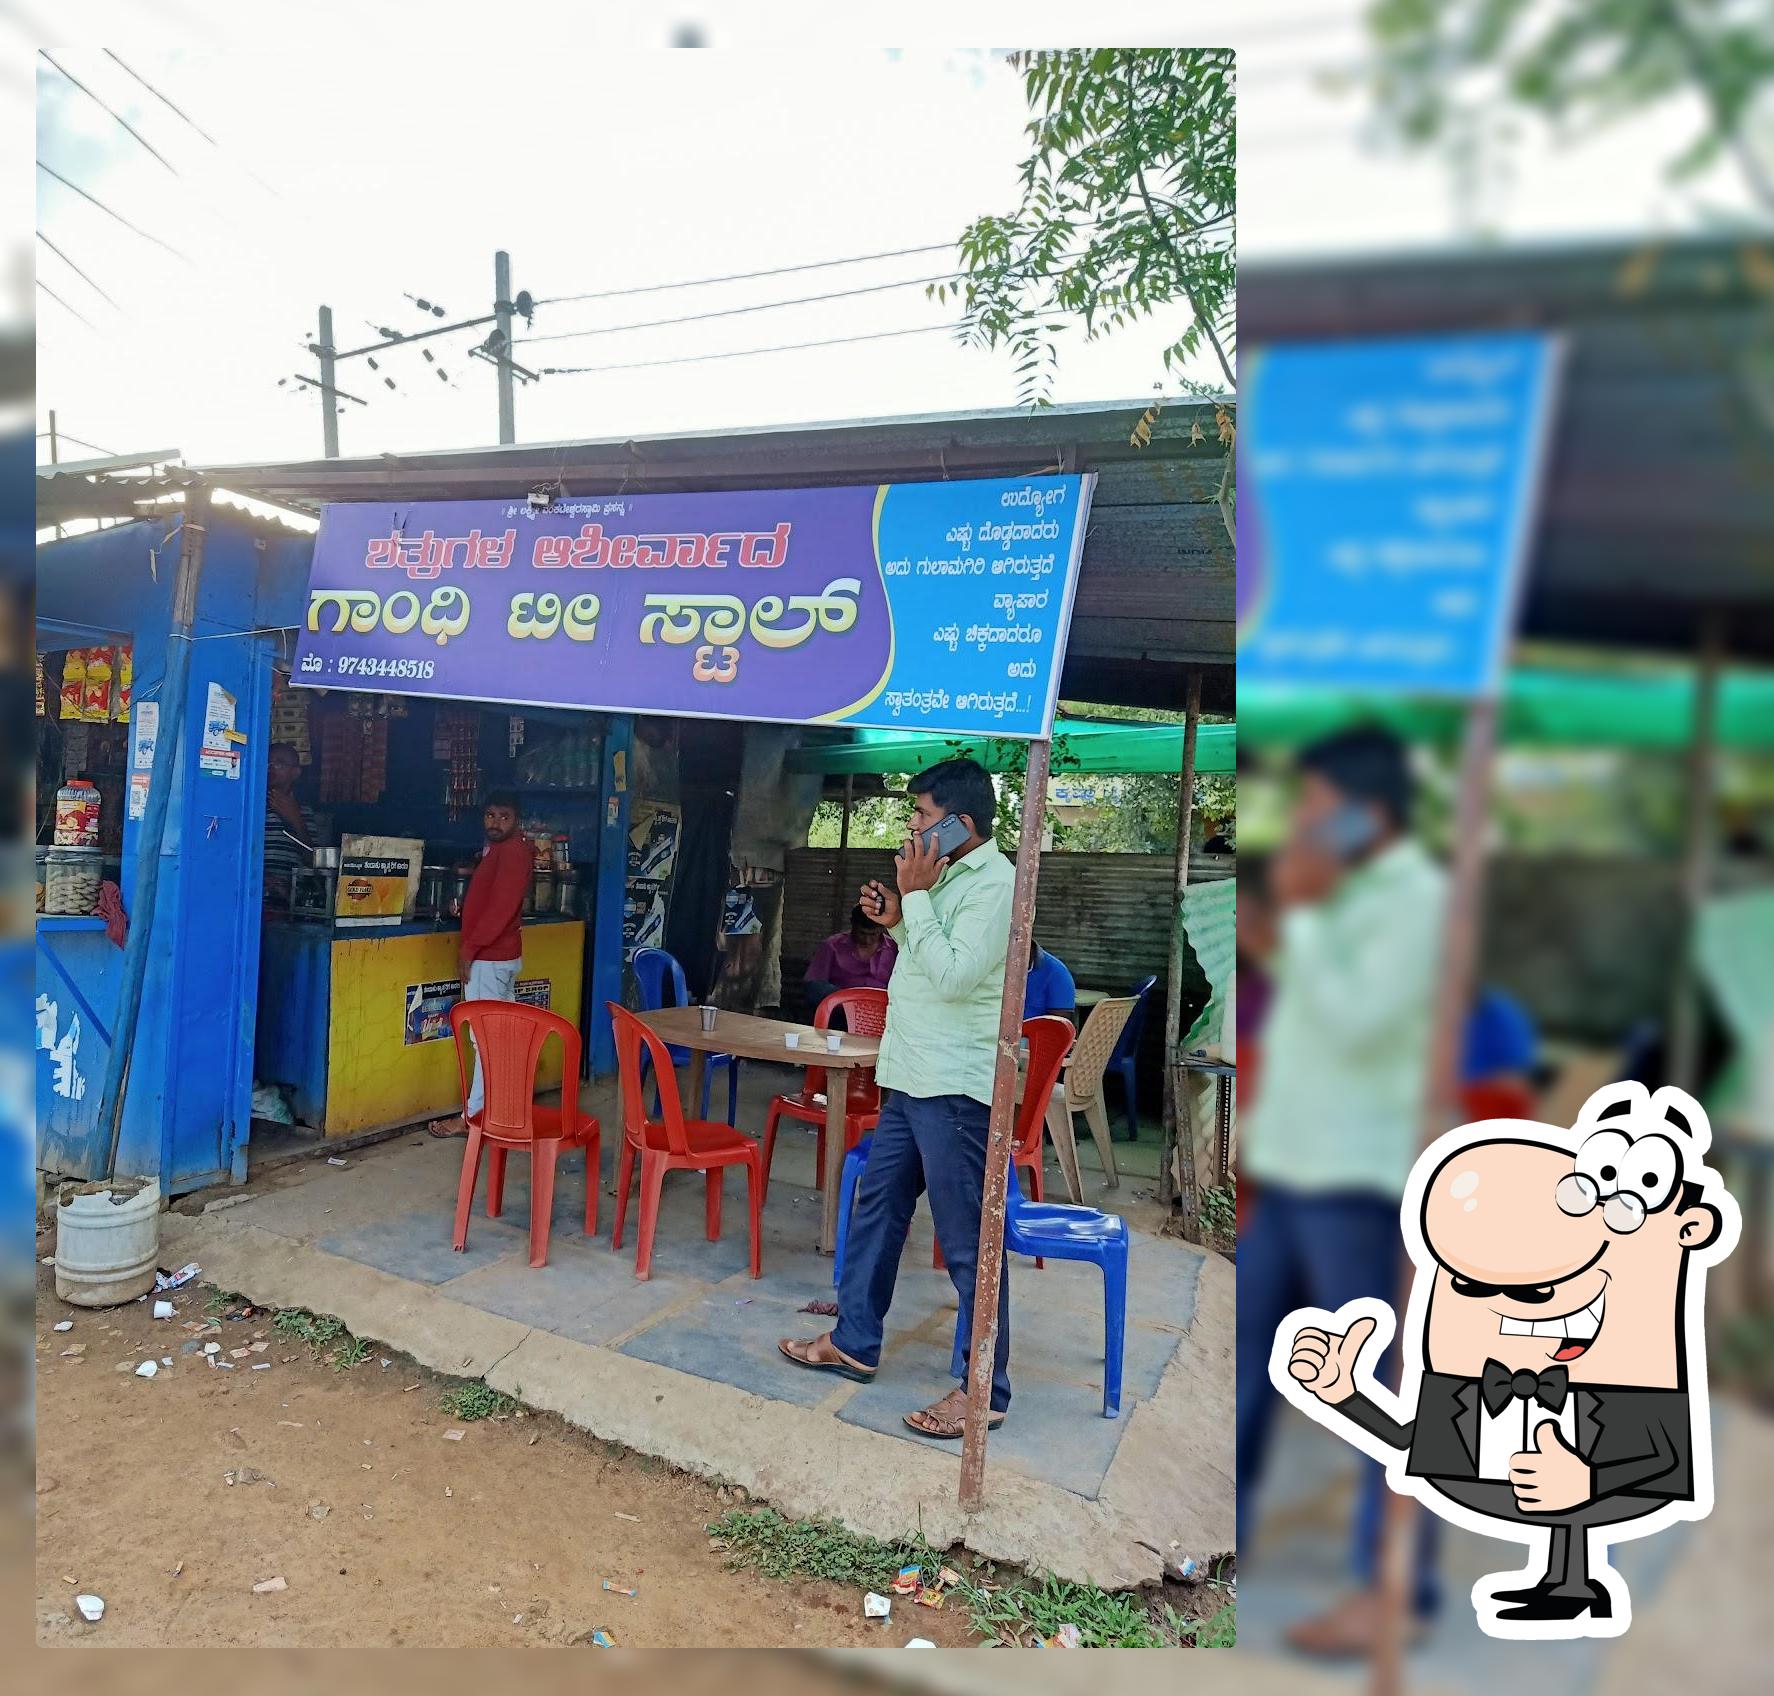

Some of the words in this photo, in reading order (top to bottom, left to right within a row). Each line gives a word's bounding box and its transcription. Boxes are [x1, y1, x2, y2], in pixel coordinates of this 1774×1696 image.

[1001, 484, 1067, 518] ಉದ್ಯೋಗ
[365, 528, 517, 580] ಶತ್ರುಗಳ
[532, 522, 791, 568] ಆಶೀರ್ವಾದ
[946, 521, 973, 552] ಎಷ್ಟು
[885, 556, 911, 576] ಅದು
[916, 556, 986, 576] ಗುಲಾಮಗಿರಿ
[991, 553, 1055, 580] ಆಗಿರುತ್ತದೆ
[993, 589, 1049, 620] ವ್ಯಾಪಾರ
[307, 586, 471, 646] ಗಾಂಧಿ
[506, 592, 602, 642] ಟೀ
[639, 577, 862, 684] ಸ್ಟಾಲ್
[933, 622, 960, 652] ಎಷ್ಟು
[965, 623, 1042, 652] ಚಿಕ್ಕದಾದರೂ
[301, 653, 323, 673] ಮೊ
[338, 656, 435, 679] 9743448518
[1007, 658, 1037, 678] ಅದು
[884, 688, 950, 717] ಸ್ವಾತಂತ್ರವೇ
